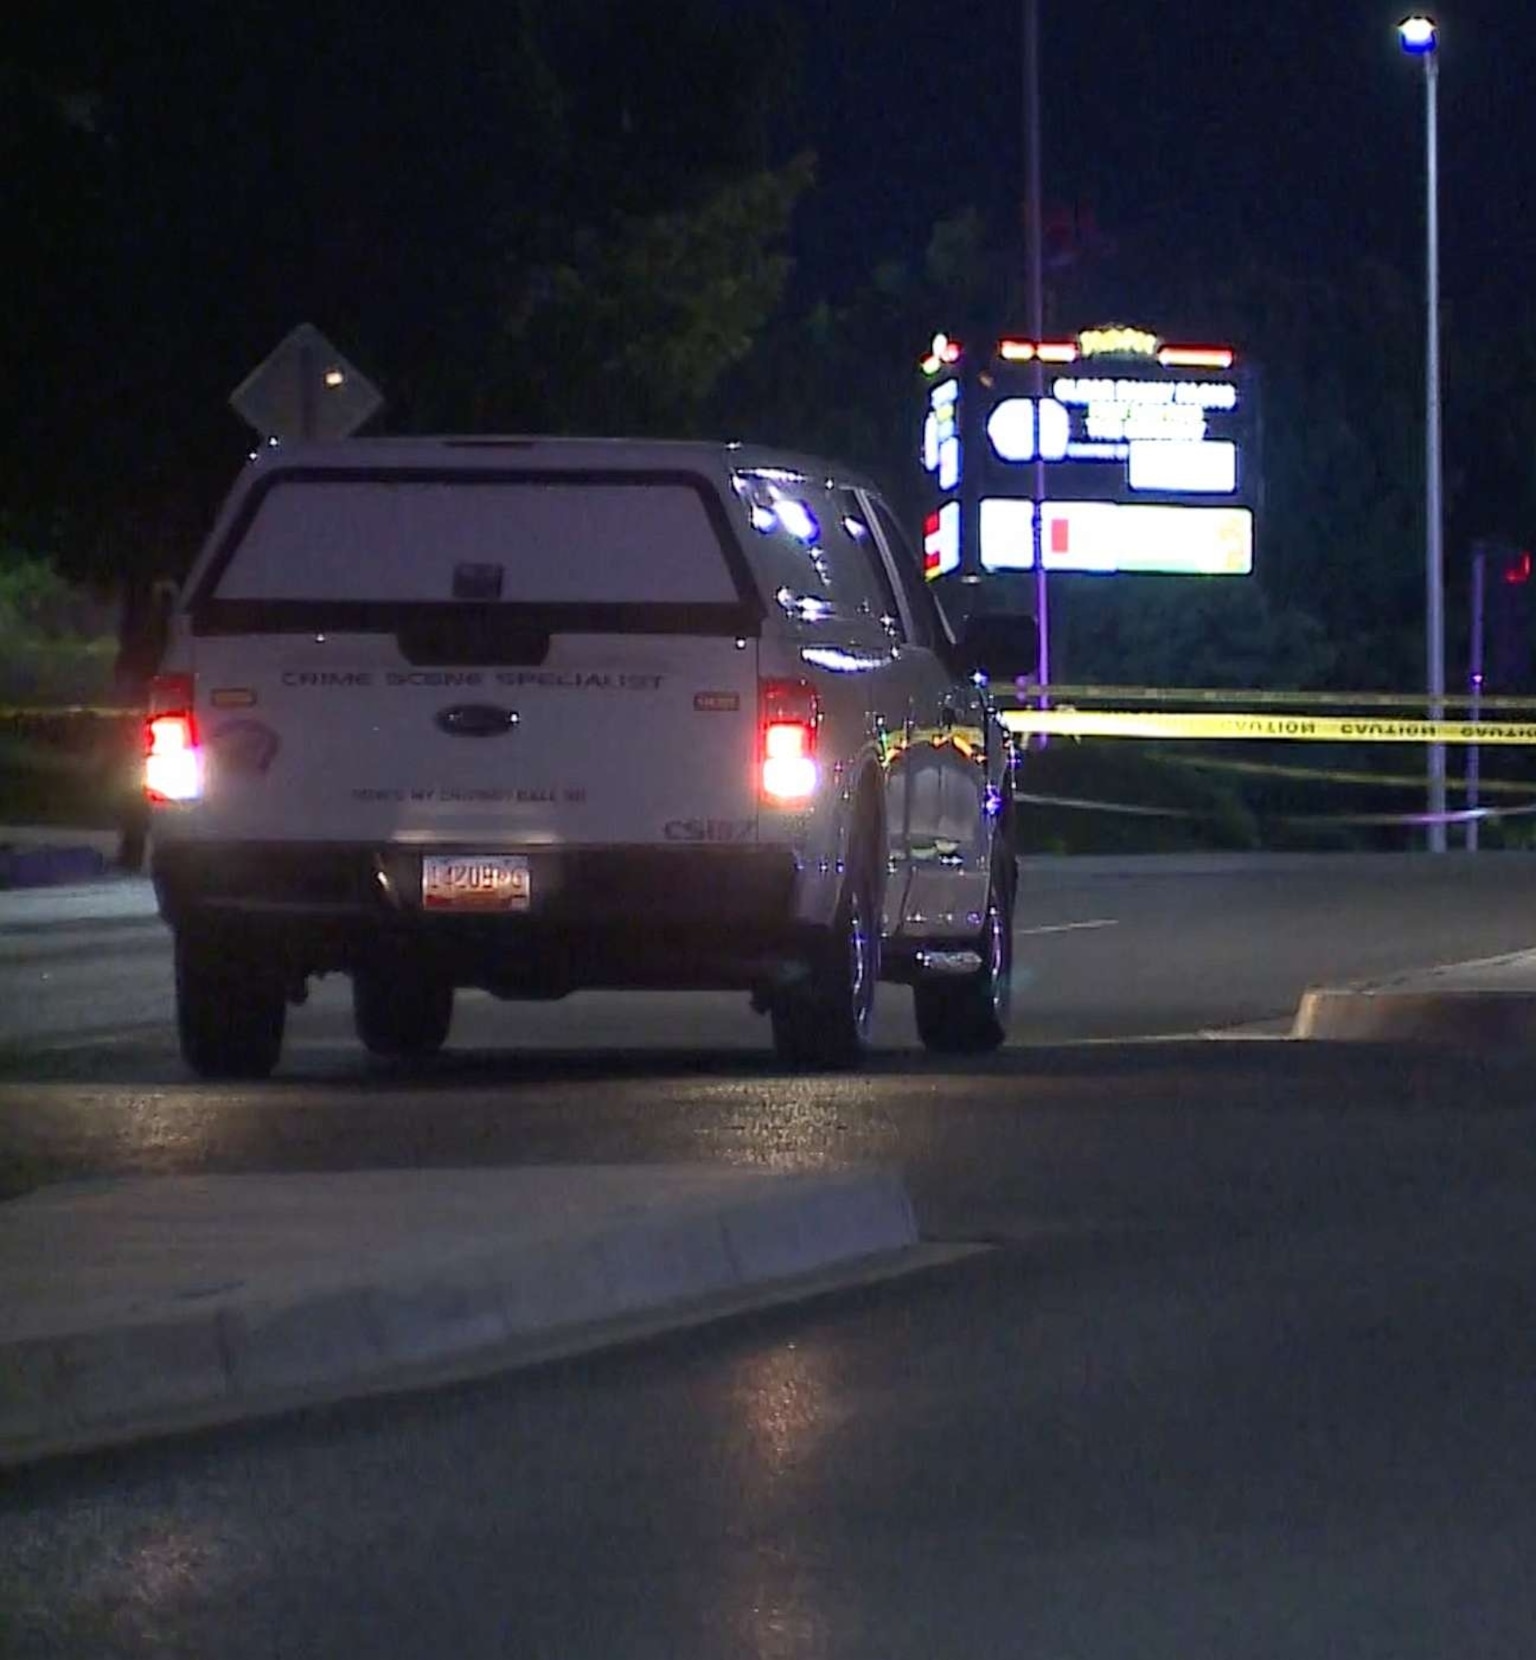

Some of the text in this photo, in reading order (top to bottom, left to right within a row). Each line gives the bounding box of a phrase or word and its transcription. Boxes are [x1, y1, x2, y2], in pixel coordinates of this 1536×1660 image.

[281, 672, 663, 690] CRIME SCENE SPECIALIST
